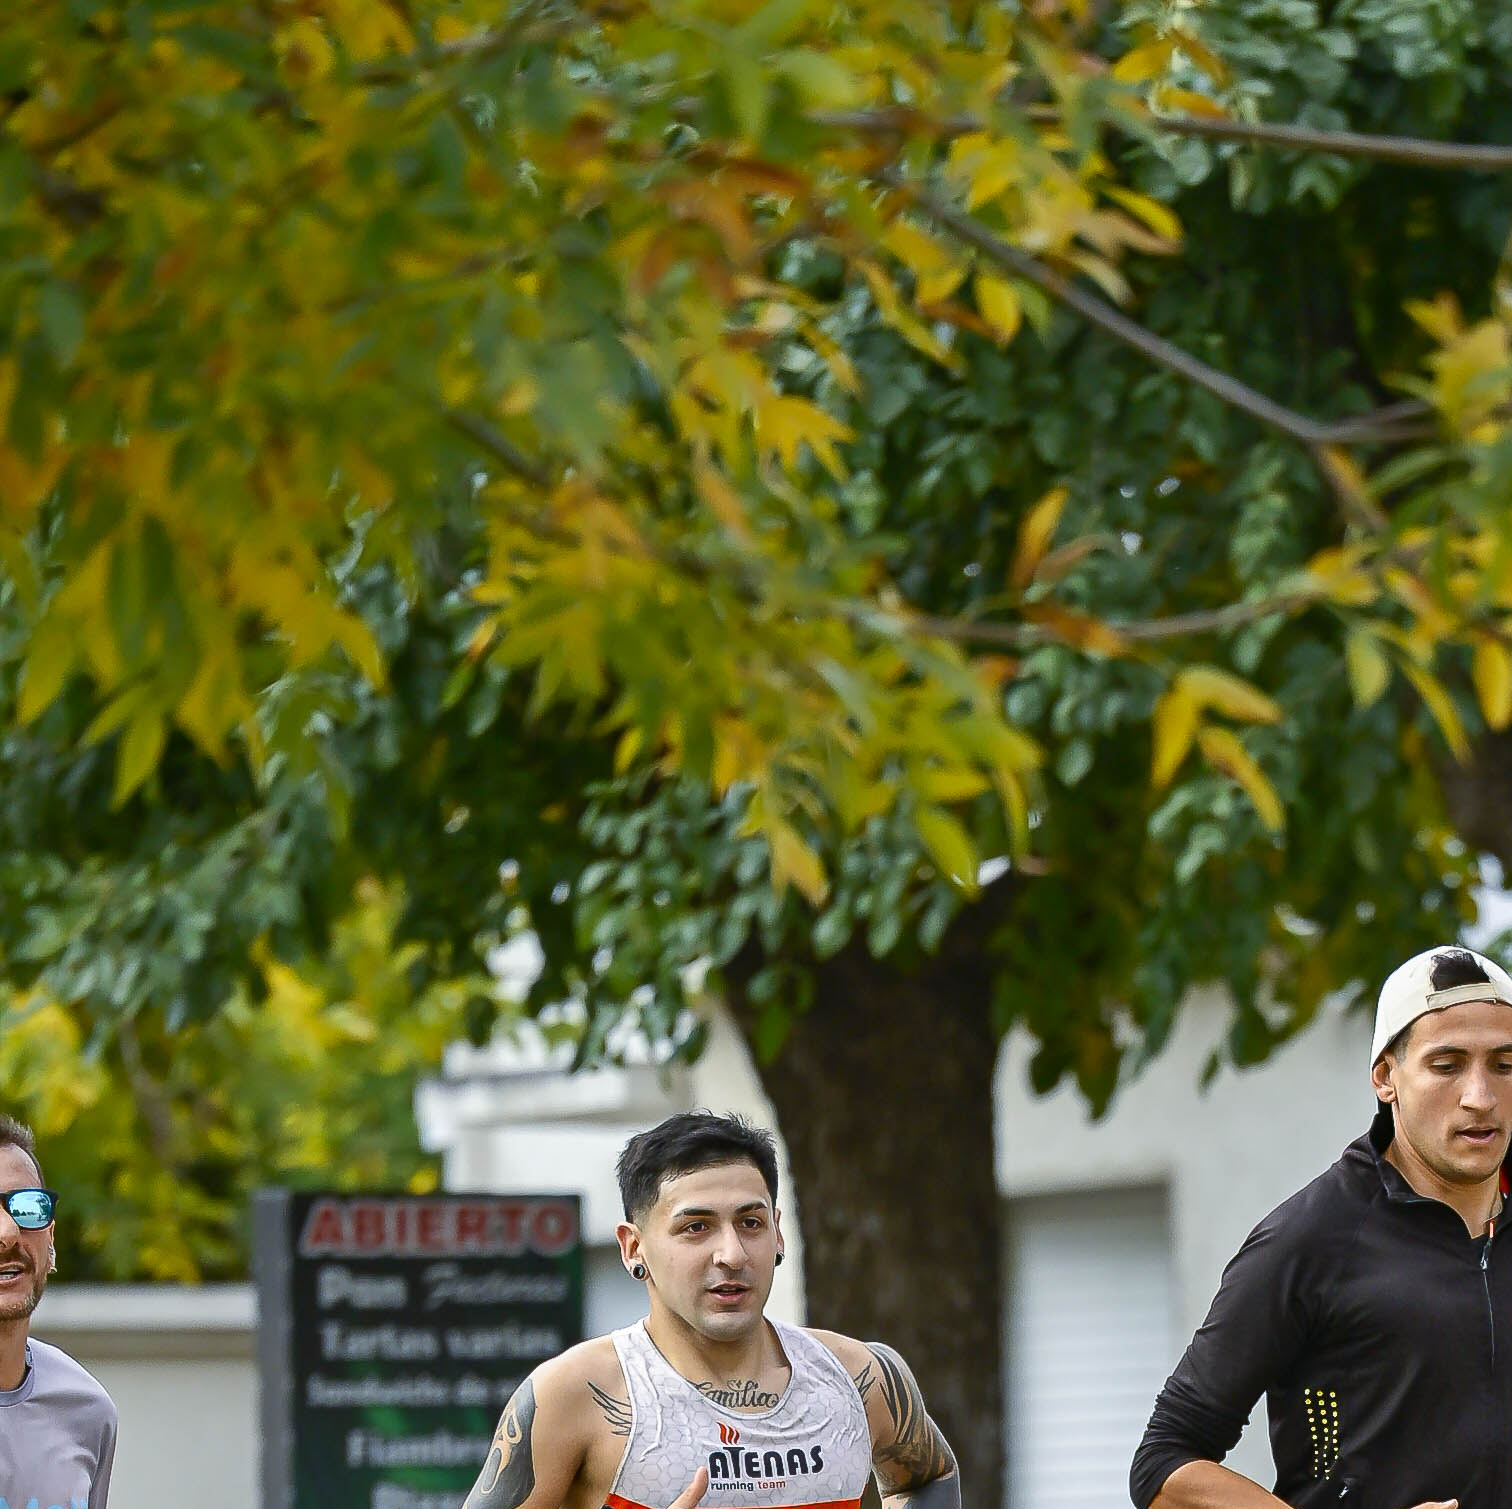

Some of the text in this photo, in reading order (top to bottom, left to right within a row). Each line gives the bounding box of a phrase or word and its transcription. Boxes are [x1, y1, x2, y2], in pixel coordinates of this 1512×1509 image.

[305, 1203, 578, 1252] ABIERTO
[708, 1445, 824, 1479] ATENAS
[710, 1480, 786, 1492] running team
